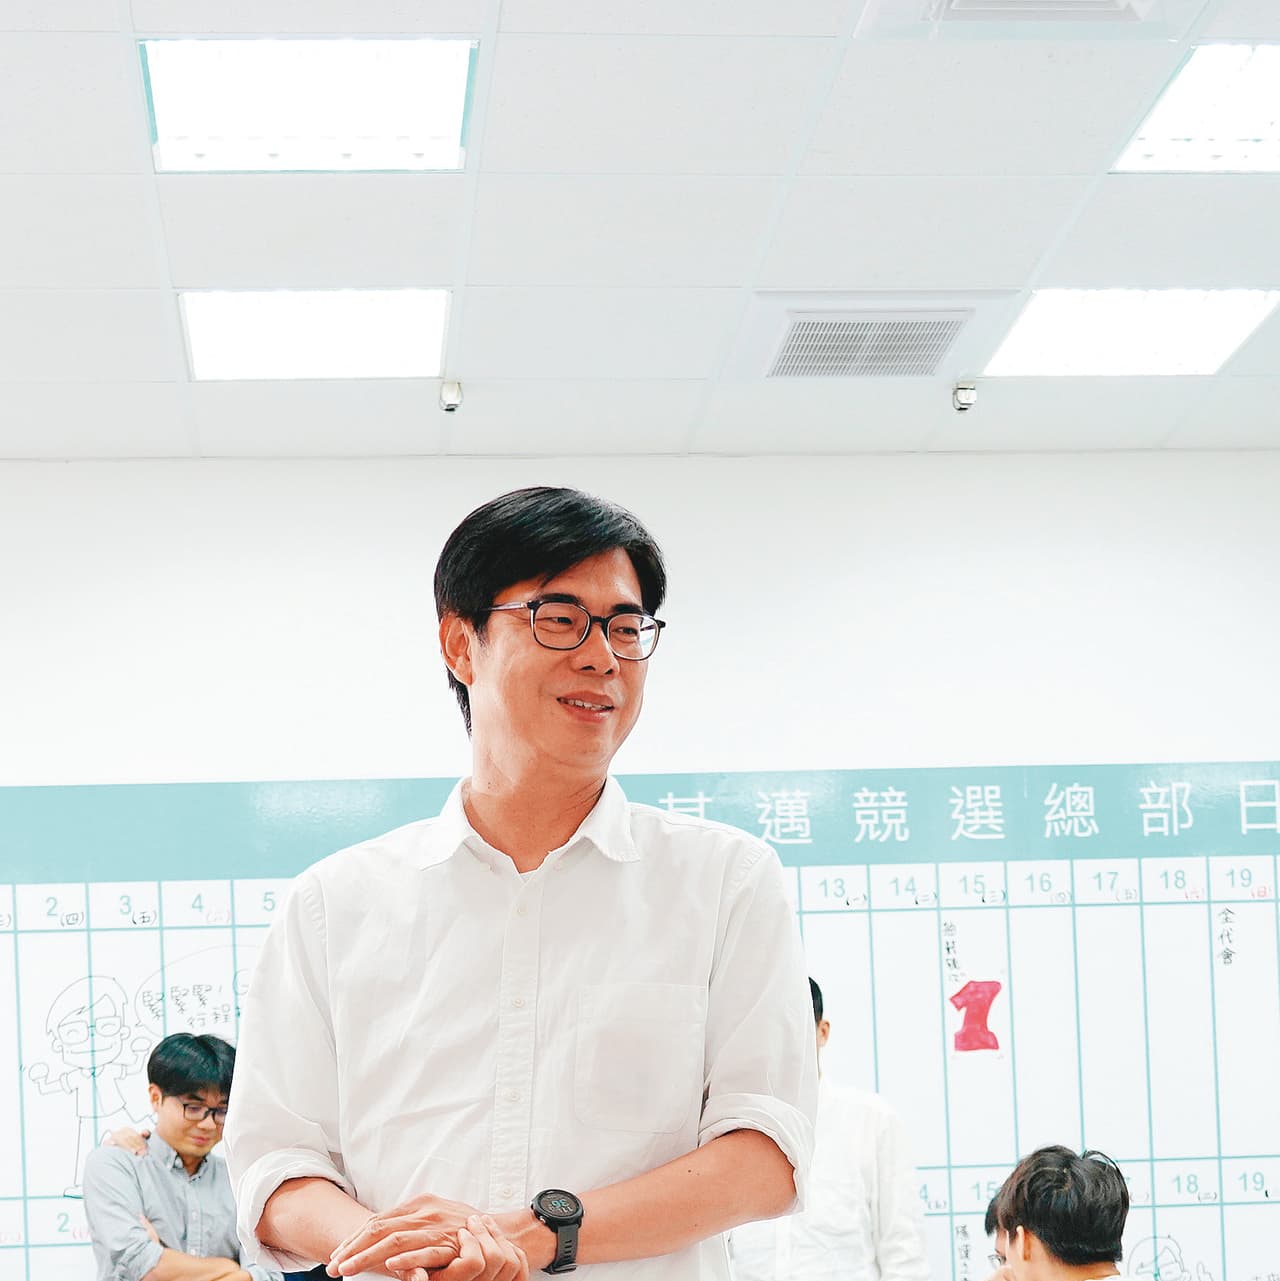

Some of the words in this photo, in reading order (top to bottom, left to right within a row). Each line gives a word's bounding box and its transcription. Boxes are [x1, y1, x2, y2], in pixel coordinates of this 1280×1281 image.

[819, 878, 847, 899] 13
[889, 876, 918, 897] 14
[959, 874, 986, 895] 15
[1024, 872, 1053, 893] 16
[1092, 871, 1120, 892] 17
[1159, 869, 1187, 890] 18
[1225, 868, 1253, 889] 19
[46, 896, 59, 917] 2
[119, 894, 133, 915] 3
[191, 892, 204, 913] 4
[263, 891, 277, 912] 5
[1171, 1174, 1200, 1195] 18
[1237, 1172, 1266, 1193] 19
[56, 1212, 71, 1233] 2
